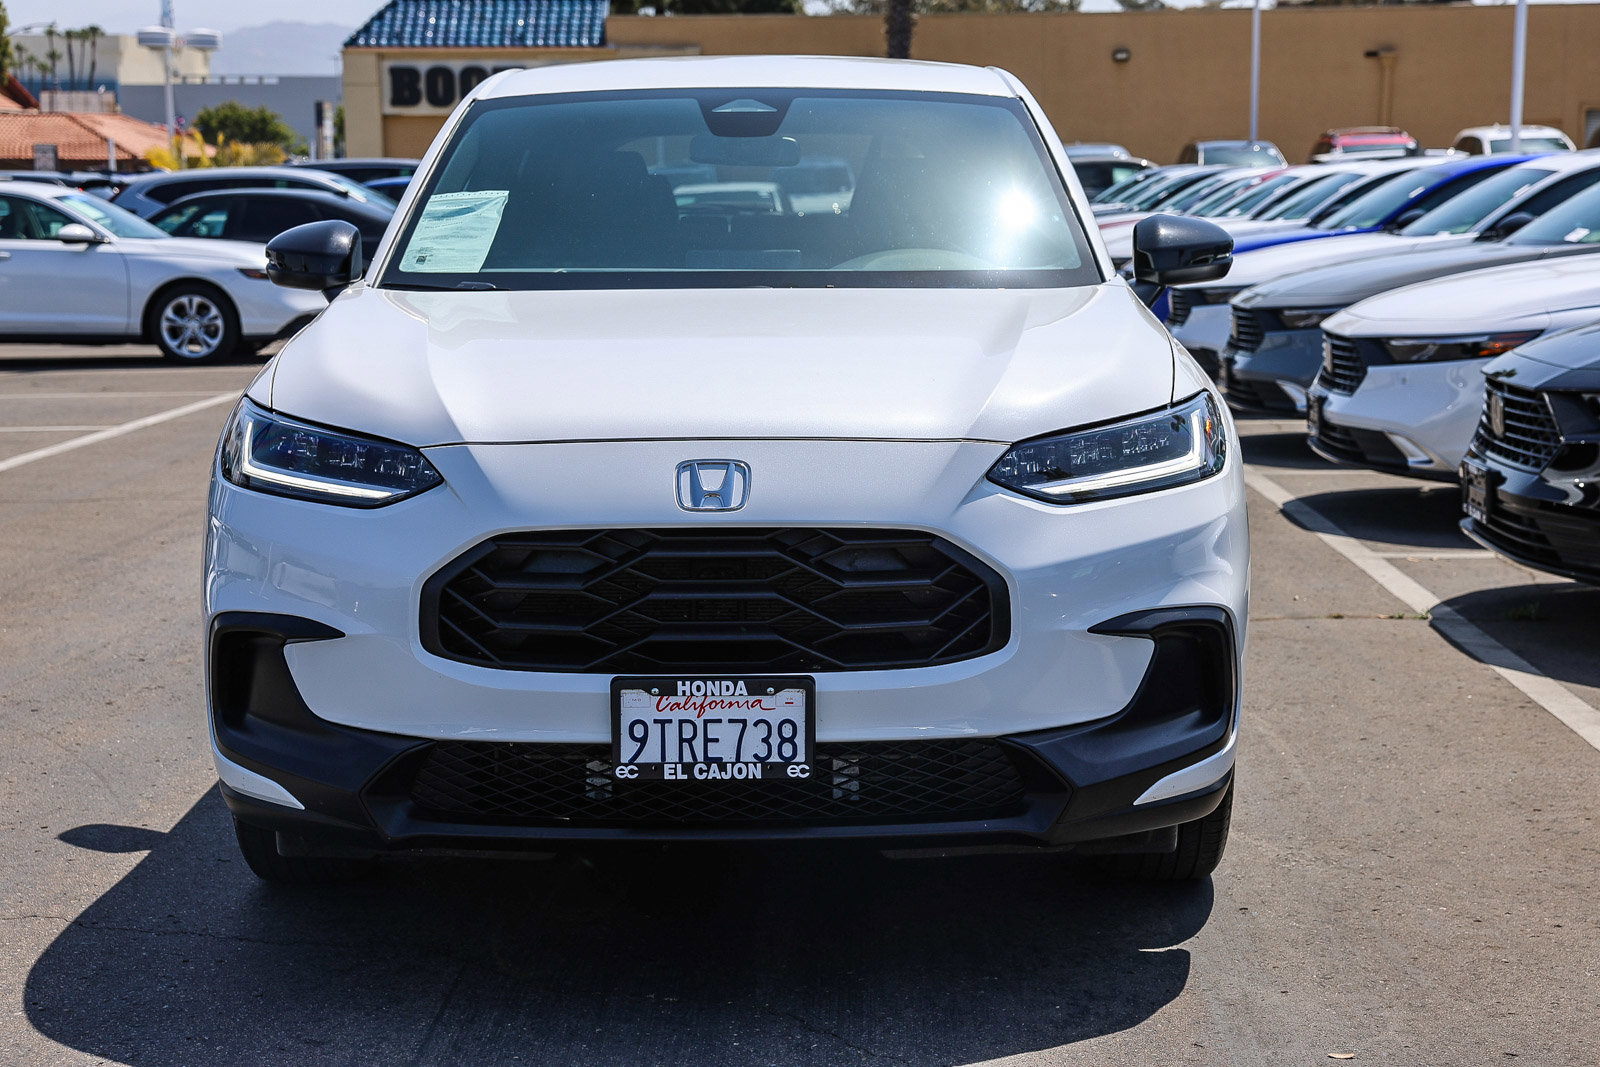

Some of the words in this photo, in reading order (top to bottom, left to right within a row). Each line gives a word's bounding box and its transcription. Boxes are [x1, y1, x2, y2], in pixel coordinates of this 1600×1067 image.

[389, 65, 526, 108] BOO
[677, 680, 748, 696] HONDA
[655, 695, 776, 718] California
[628, 718, 798, 763] 9TRE738
[663, 763, 688, 780] EL
[693, 763, 762, 780] CAJON
